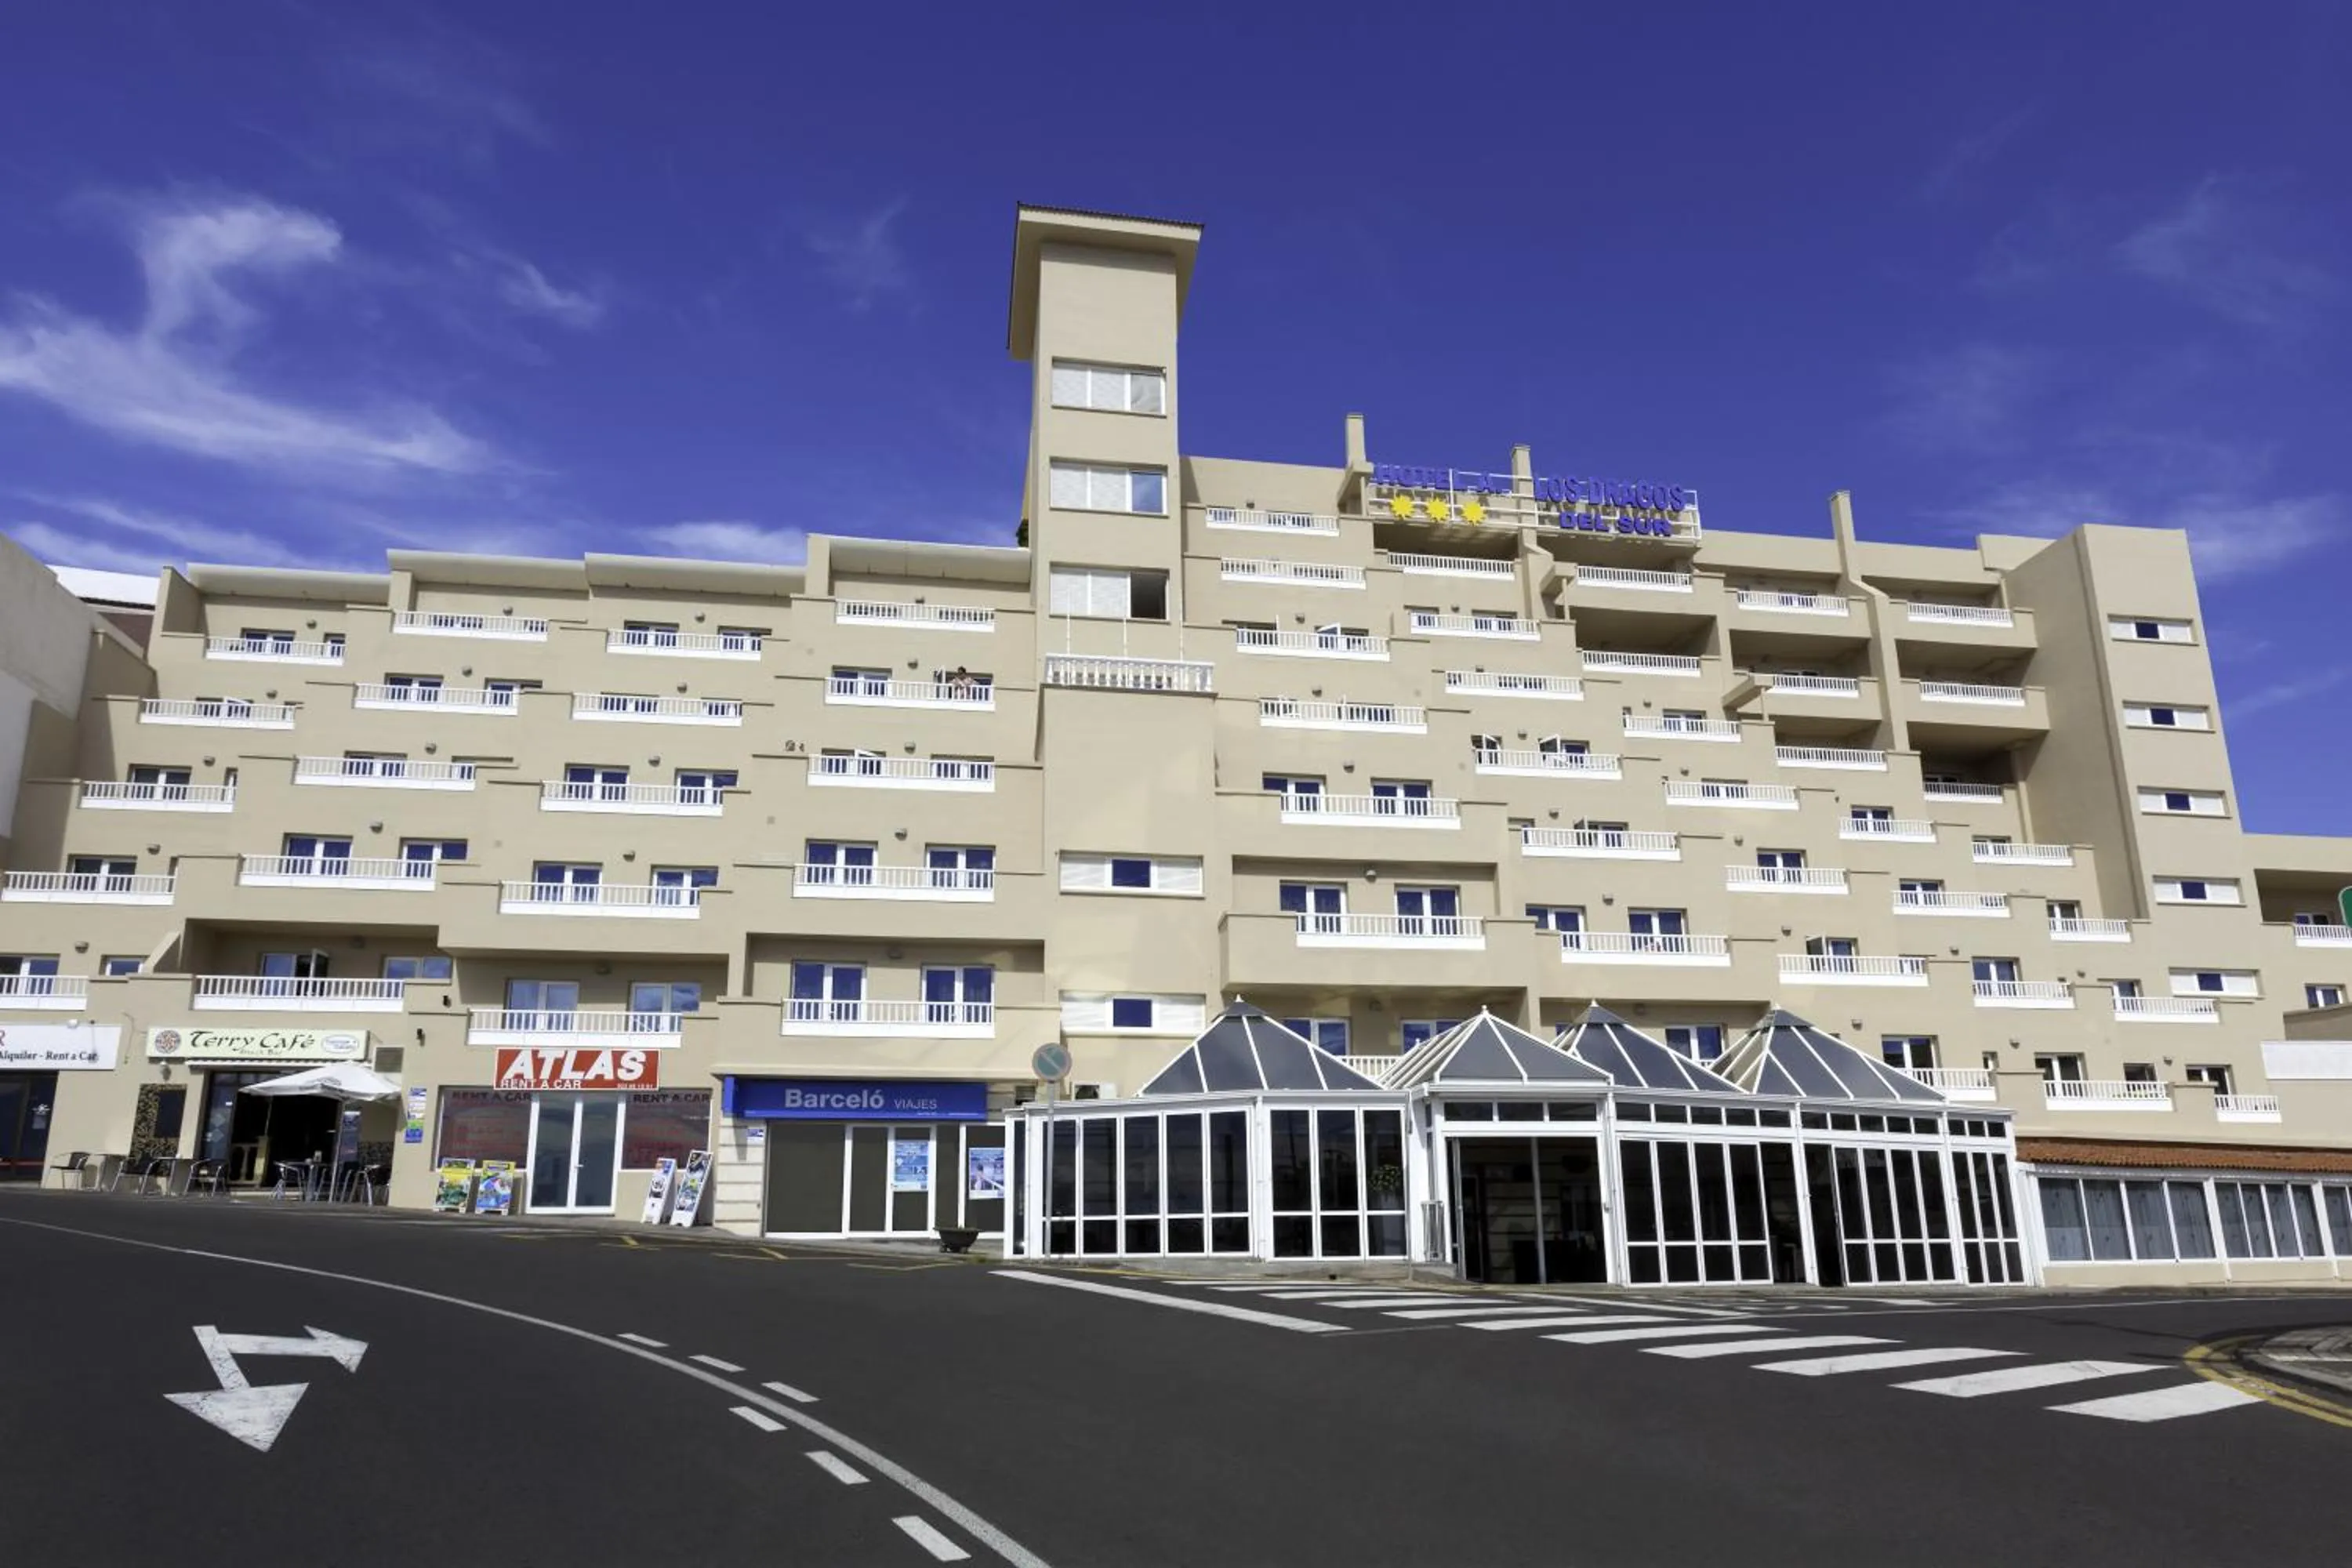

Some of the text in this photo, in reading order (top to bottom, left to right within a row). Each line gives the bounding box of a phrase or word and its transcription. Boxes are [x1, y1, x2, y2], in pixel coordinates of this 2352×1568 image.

[1534, 474, 1685, 513] LOS DRAGOS
[1559, 512, 1671, 536] DEL SUR
[189, 1030, 255, 1051] Terry
[45, 1051, 70, 1061] Rent
[79, 1051, 98, 1061] Car
[502, 1049, 647, 1081] ATLAS
[500, 1079, 582, 1089] RENT A CAR
[633, 1094, 669, 1103] RENT
[785, 1088, 938, 1110] Barceló VIAJES
